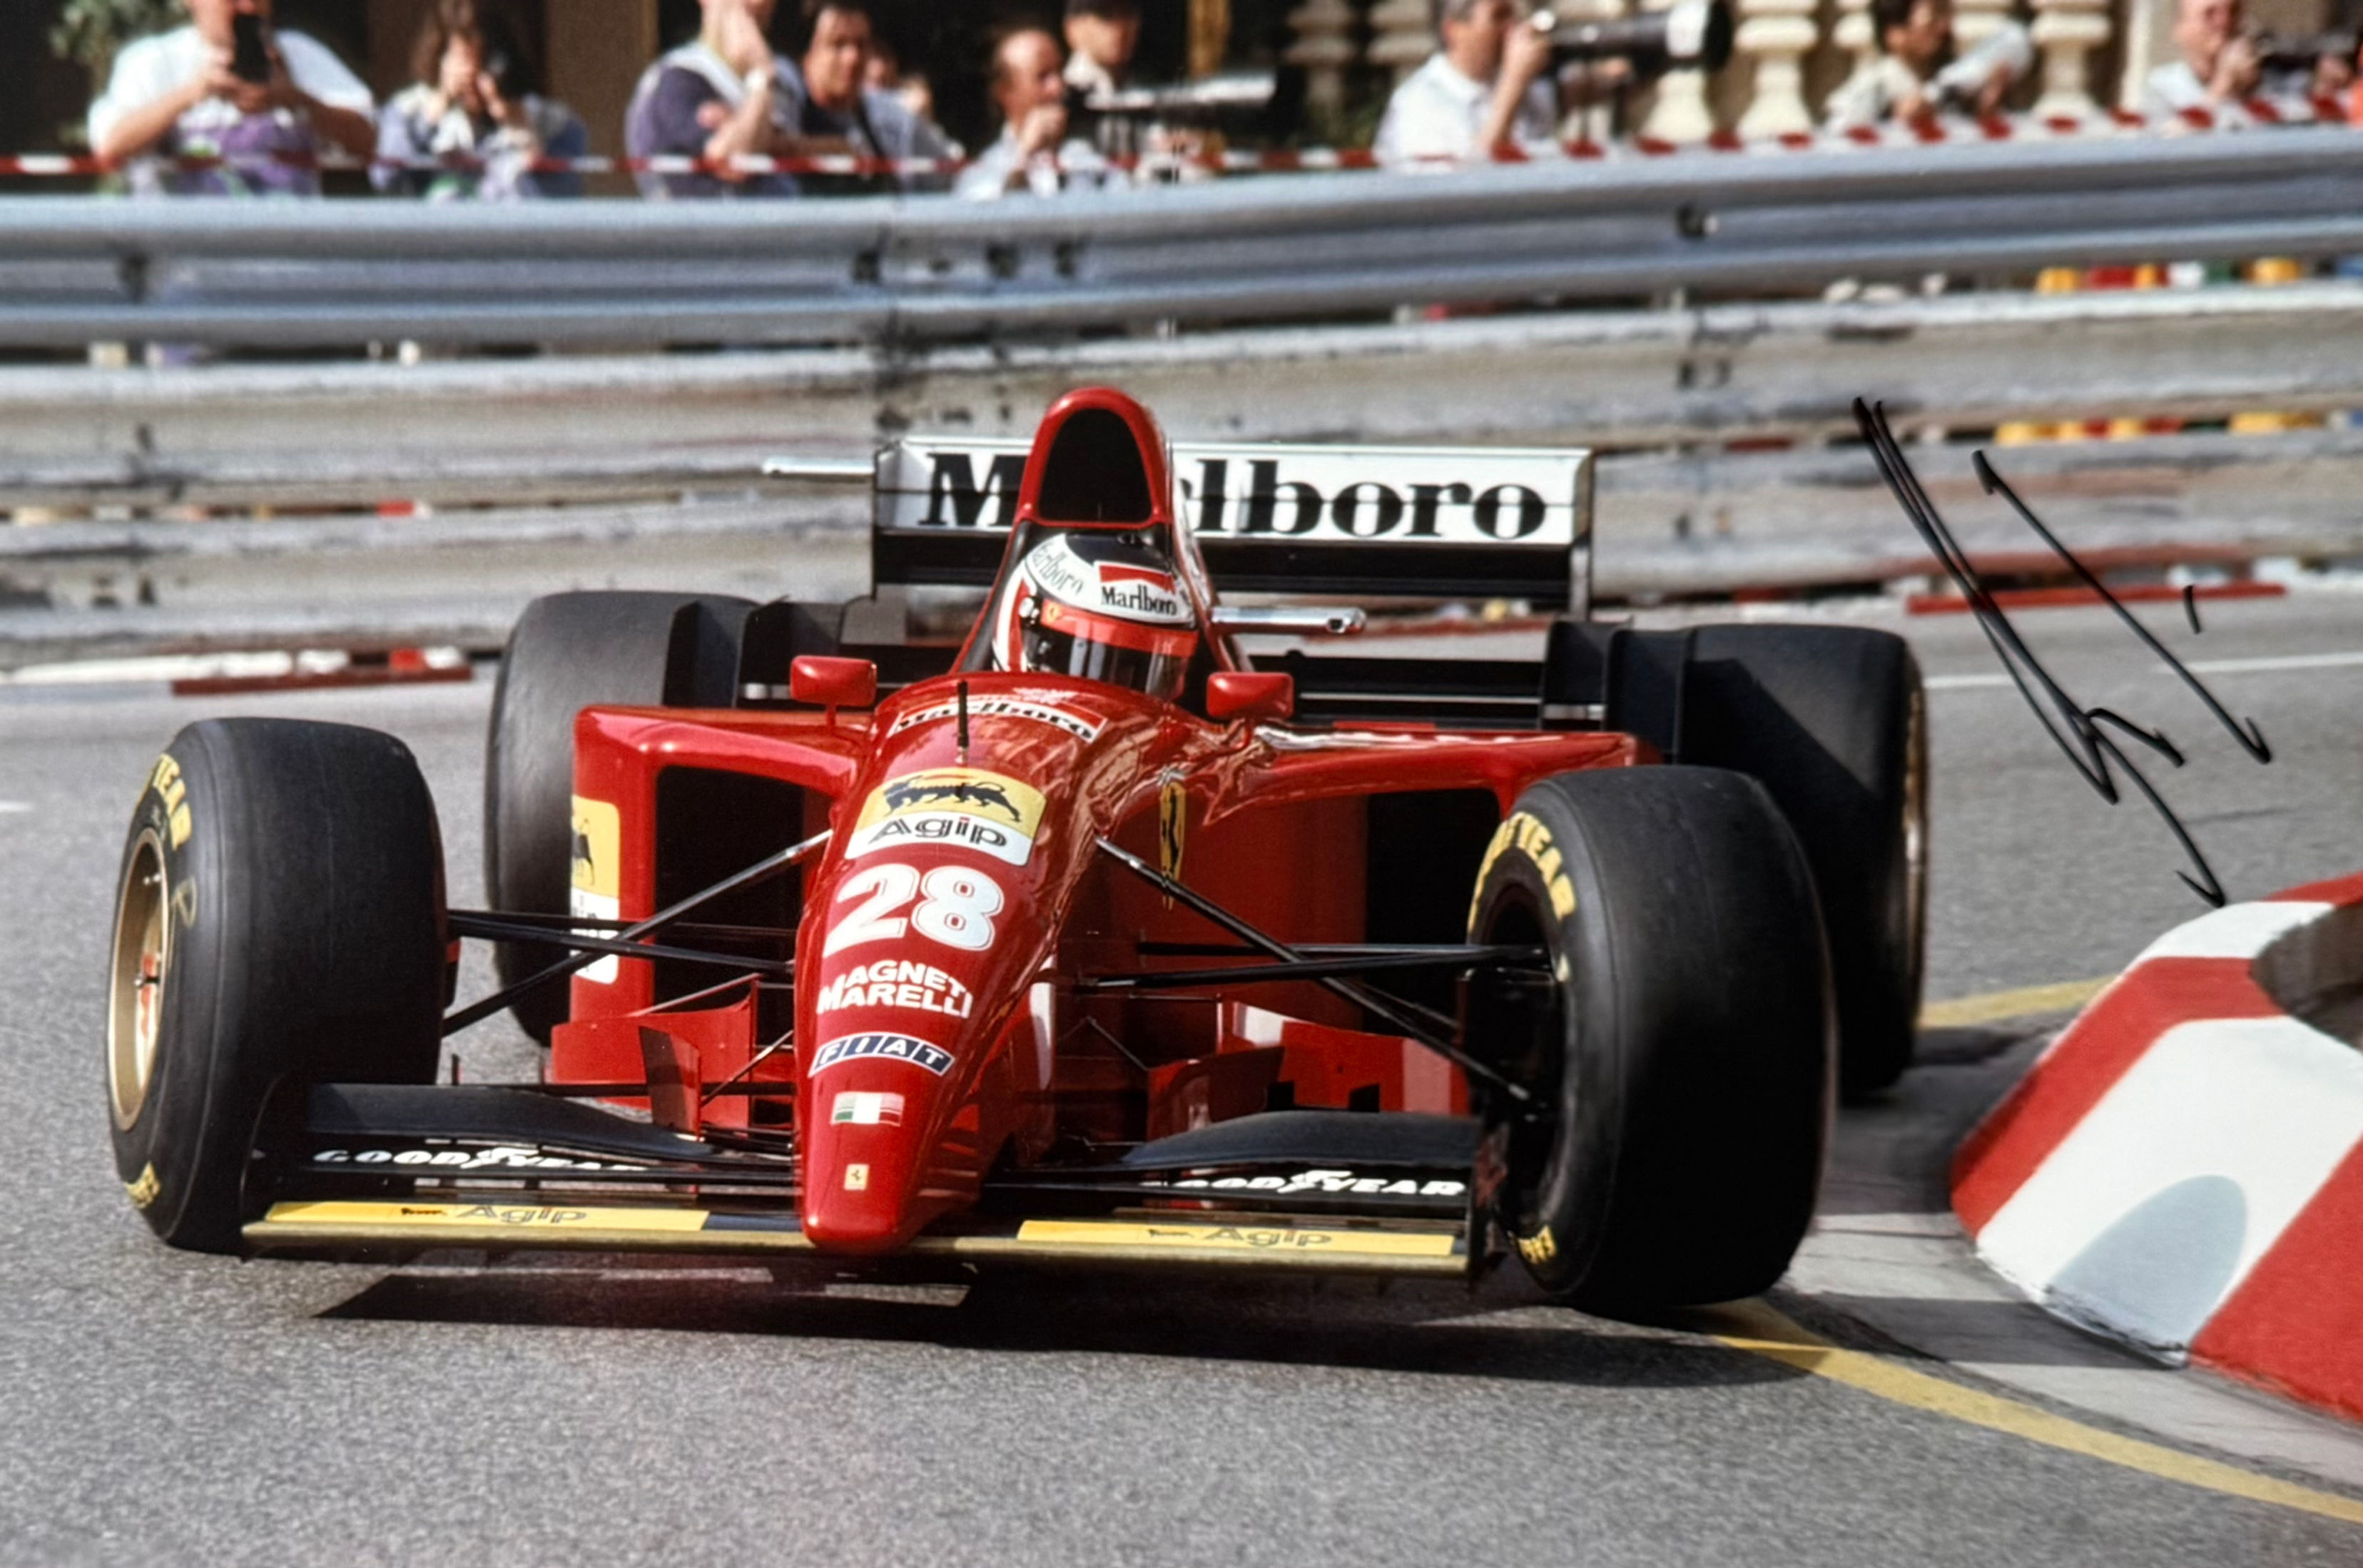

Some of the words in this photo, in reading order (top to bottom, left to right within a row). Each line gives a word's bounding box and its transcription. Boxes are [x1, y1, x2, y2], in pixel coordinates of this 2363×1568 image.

[919, 452, 1547, 540] Mlboro
[868, 817, 1007, 847] Agip
[822, 862, 1005, 959] 28
[816, 959, 973, 1004] MAGNETI
[816, 974, 973, 1019] MARELLI
[818, 1036, 946, 1066] FIAT
[457, 1205, 587, 1224] Agip
[1202, 1227, 1332, 1247] Agip
